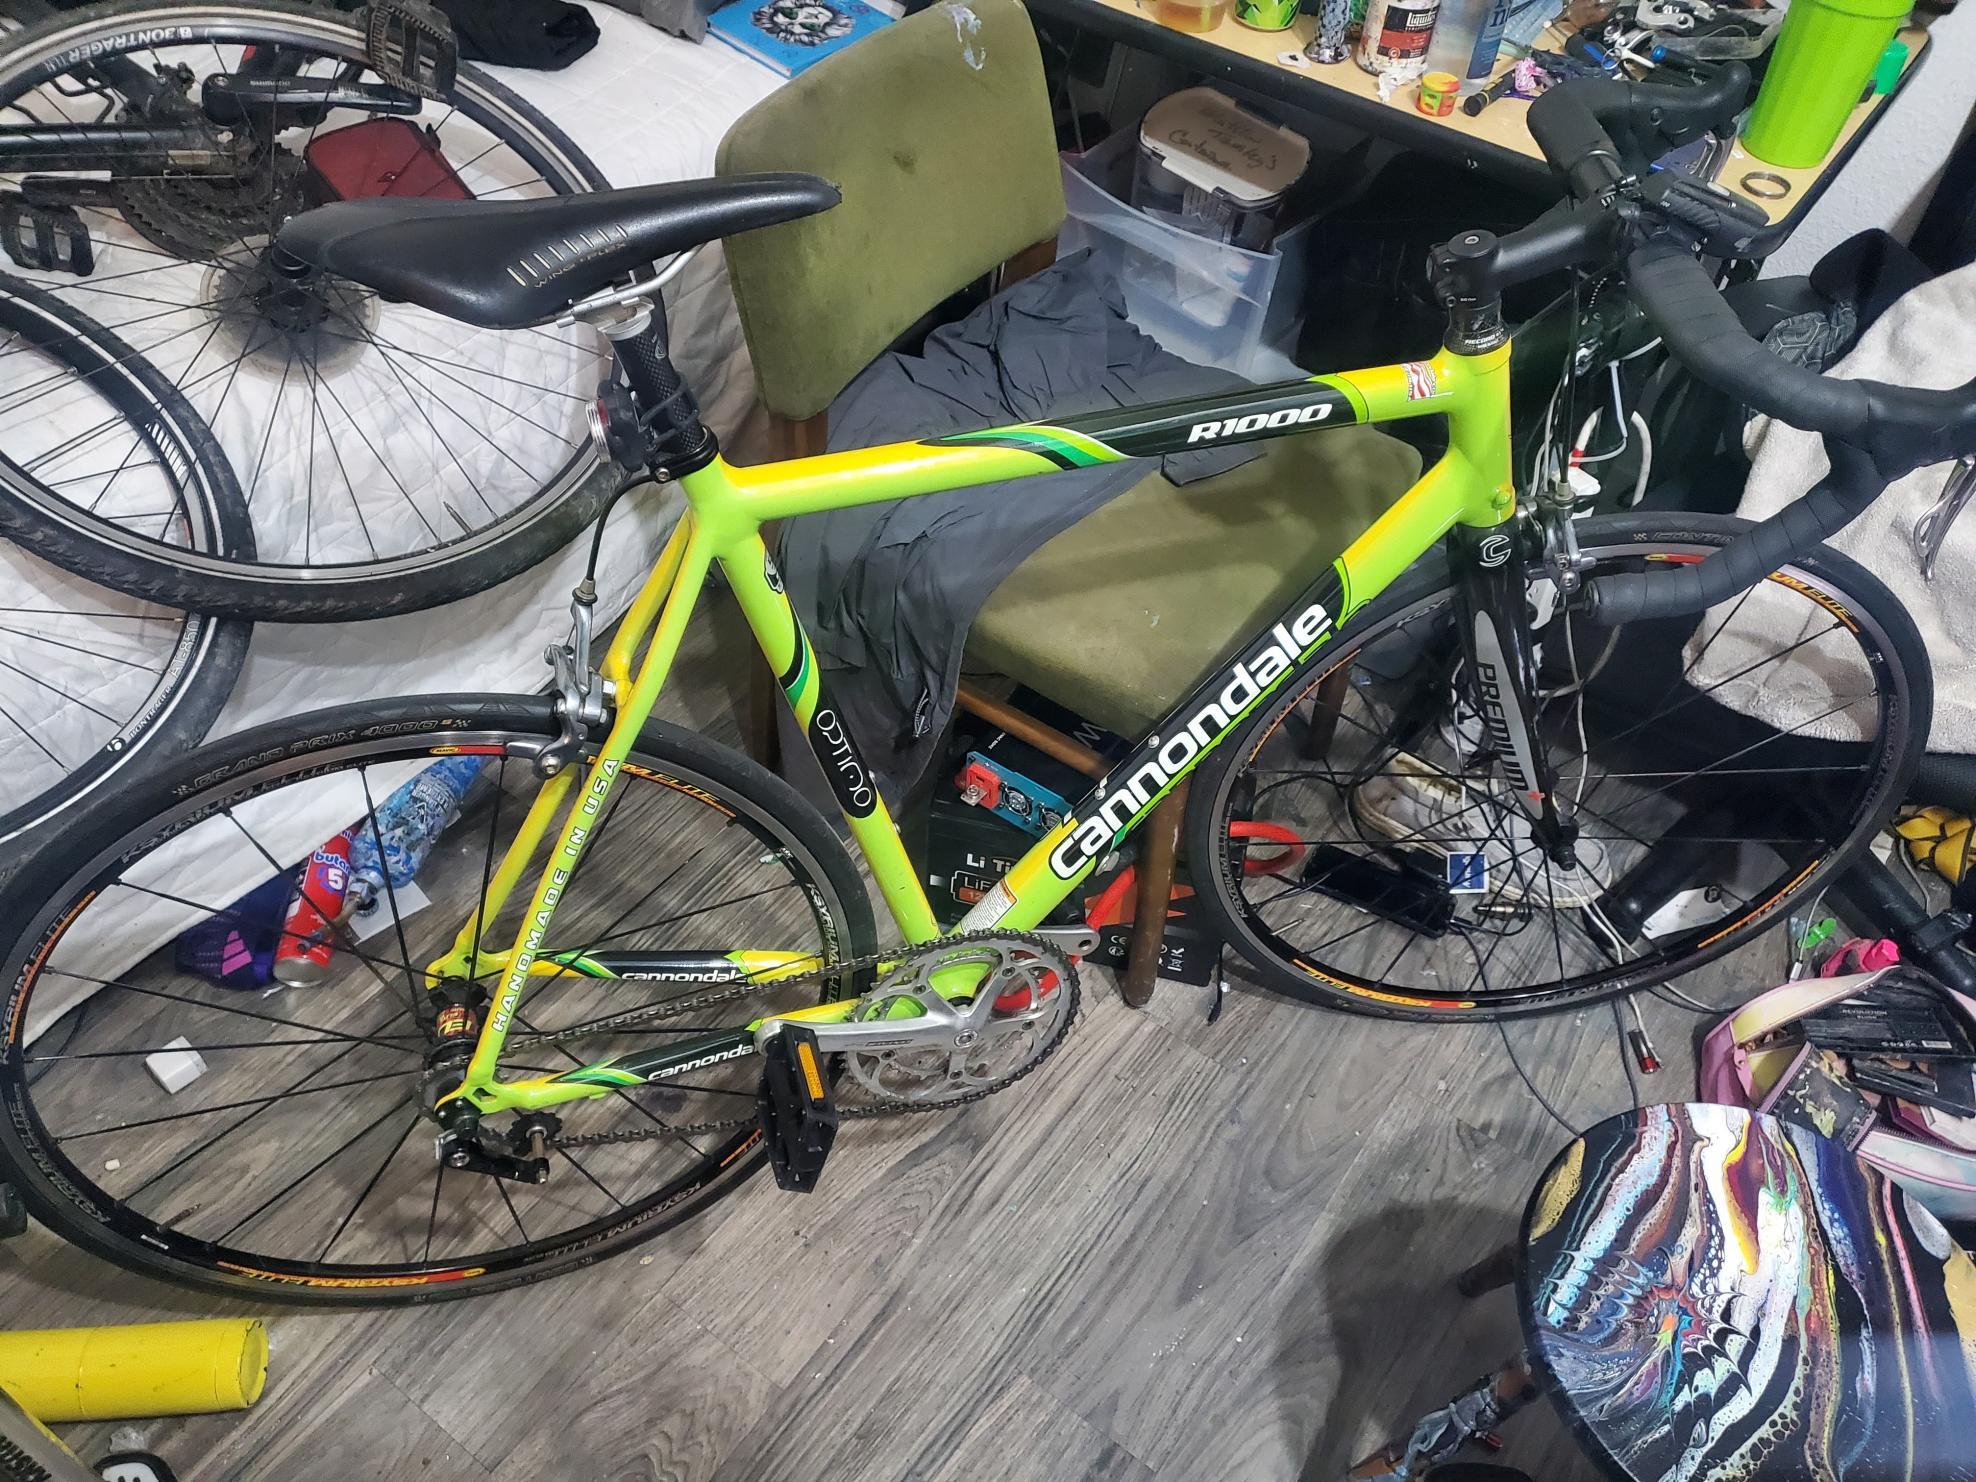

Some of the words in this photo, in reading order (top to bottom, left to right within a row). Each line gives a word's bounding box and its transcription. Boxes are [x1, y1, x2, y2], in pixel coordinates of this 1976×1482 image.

[1187, 403, 1333, 443] R1000
[171, 621, 200, 679] AT-850
[129, 686, 172, 739] BONTRAGER
[1050, 603, 1333, 880] cannondale
[1476, 662, 1529, 791] PREMIUM
[193, 746, 285, 788] GRAND
[289, 729, 354, 754] PRIX
[360, 719, 438, 737] 4000
[328, 868, 344, 891] 5
[966, 853, 986, 869] Li
[993, 858, 1014, 874] Ti
[492, 867, 569, 1033] HANDMADE
[564, 826, 587, 857] IN
[582, 758, 620, 816] USA
